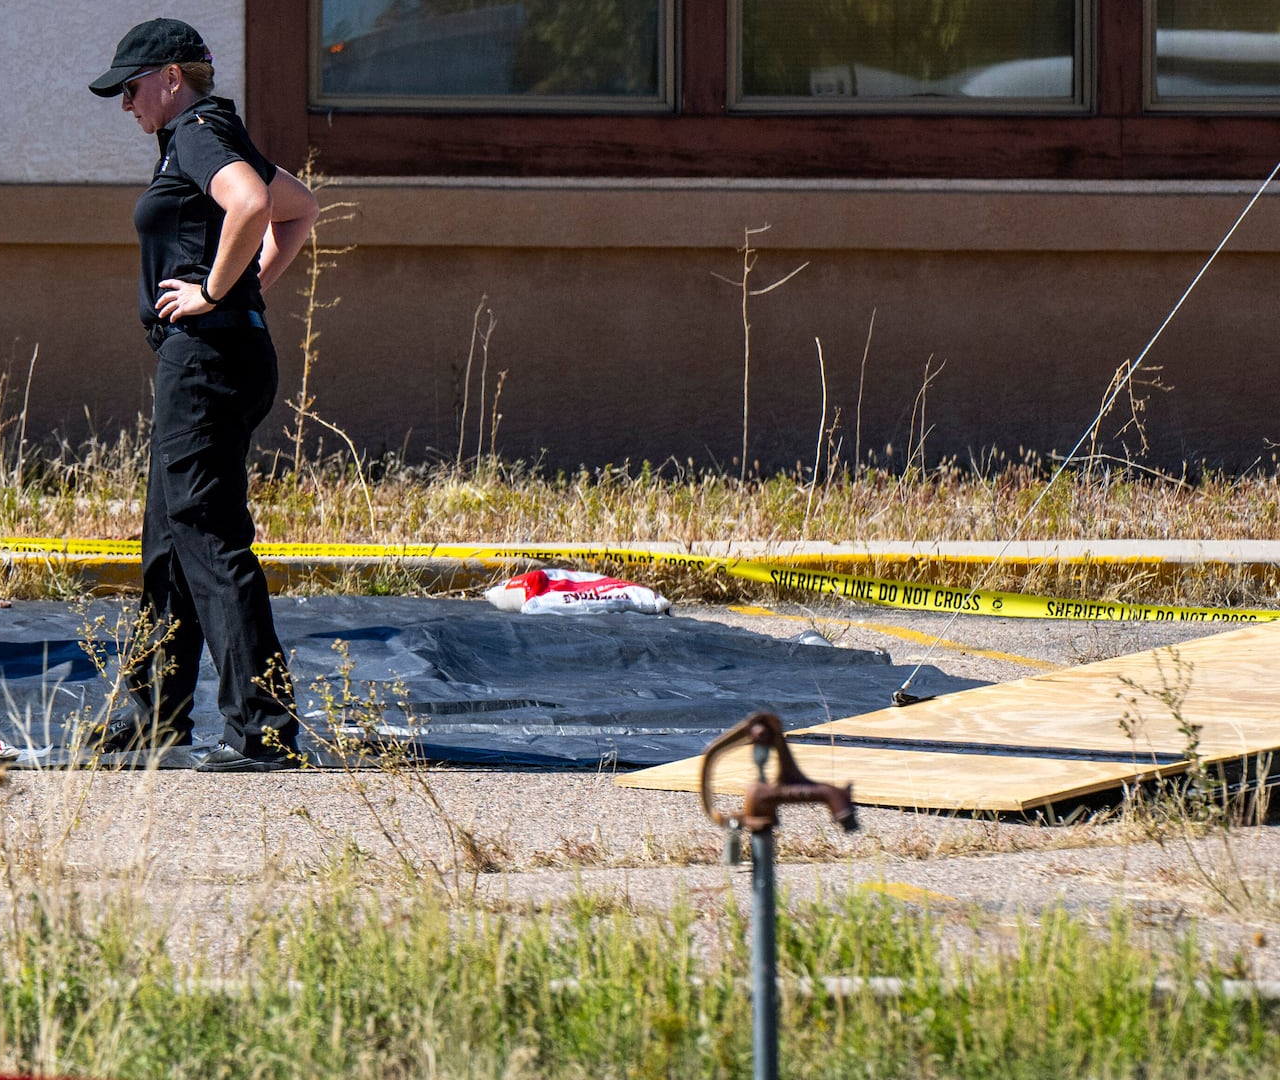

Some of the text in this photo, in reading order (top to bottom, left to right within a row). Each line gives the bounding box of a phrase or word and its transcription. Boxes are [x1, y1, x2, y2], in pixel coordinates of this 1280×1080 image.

[770, 569, 981, 611] SHERIFF'S LINE DO NOT CROSS
[1045, 601, 1115, 618] SHERIFF'S
